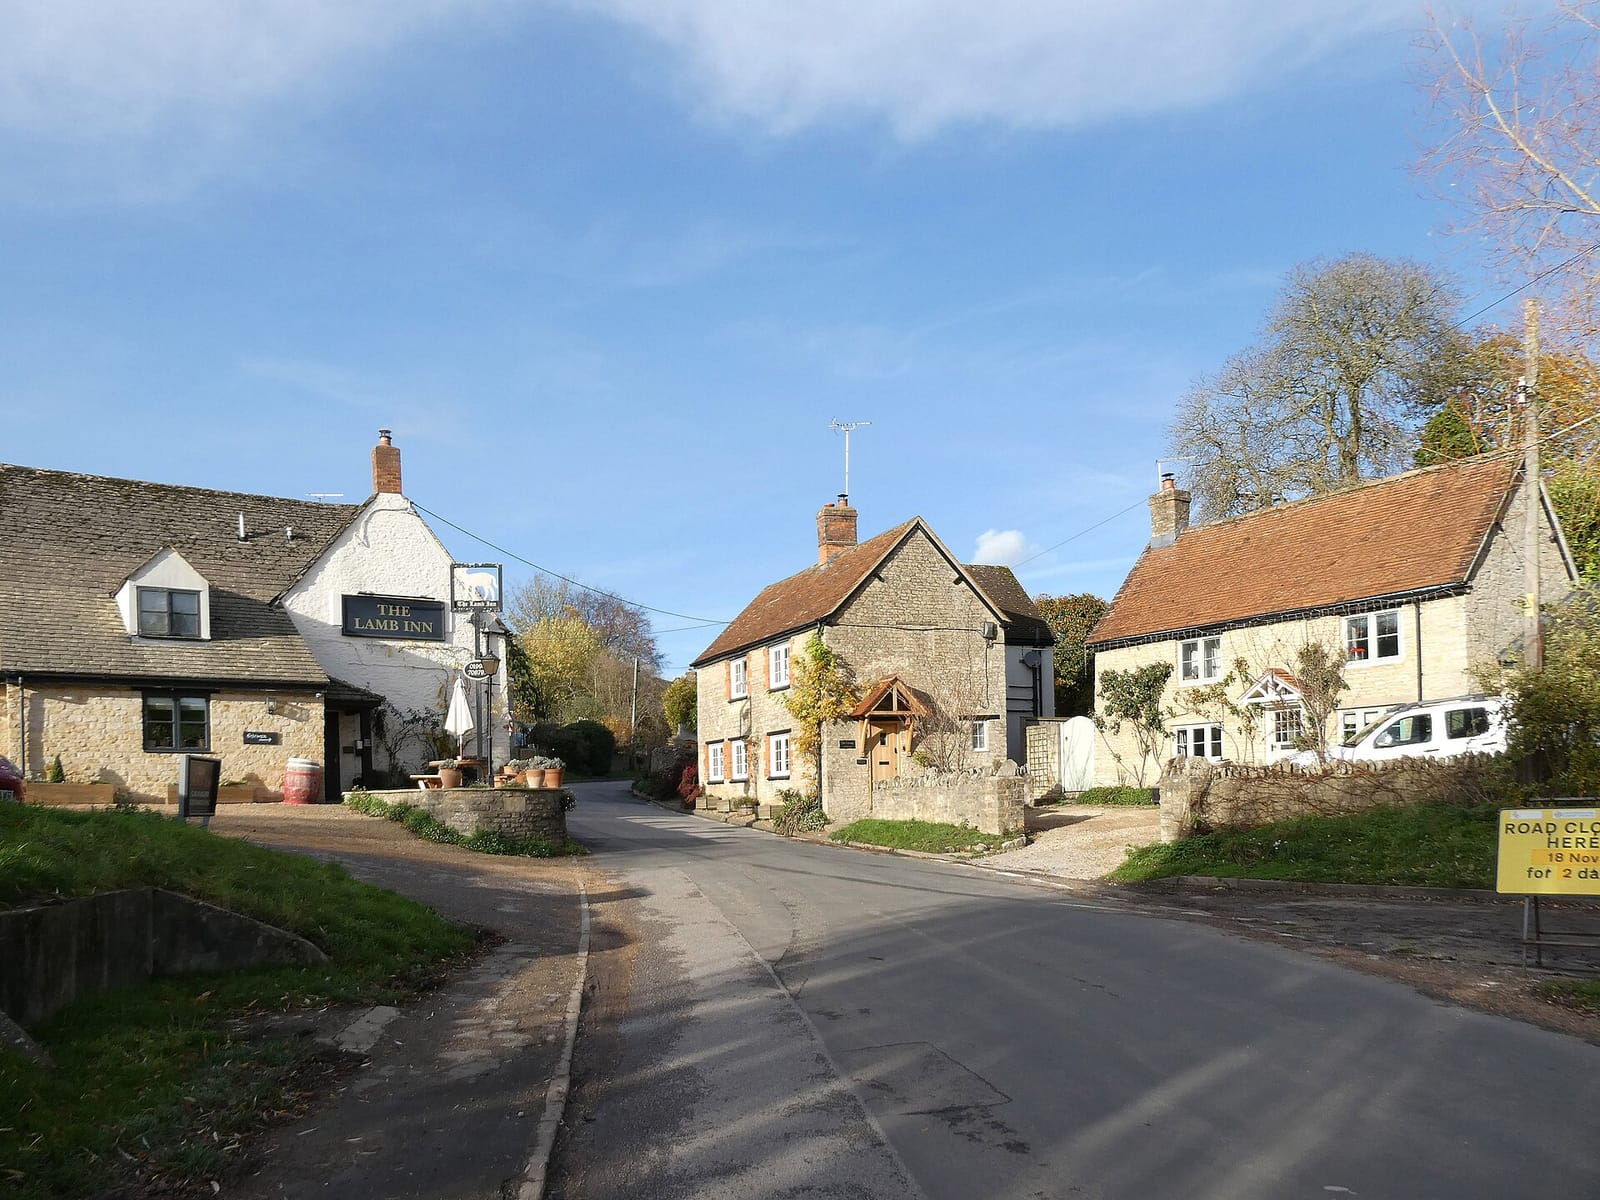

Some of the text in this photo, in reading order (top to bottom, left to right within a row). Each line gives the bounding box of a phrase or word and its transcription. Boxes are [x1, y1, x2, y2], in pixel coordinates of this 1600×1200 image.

[377, 604, 411, 617] THE
[354, 618, 433, 633] LAMB INN
[1505, 822, 1600, 834] ROAD CLO
[1547, 837, 1599, 848] HERE
[1548, 853, 1599, 863] 18 Nov
[1527, 867, 1600, 879] for 2 da
